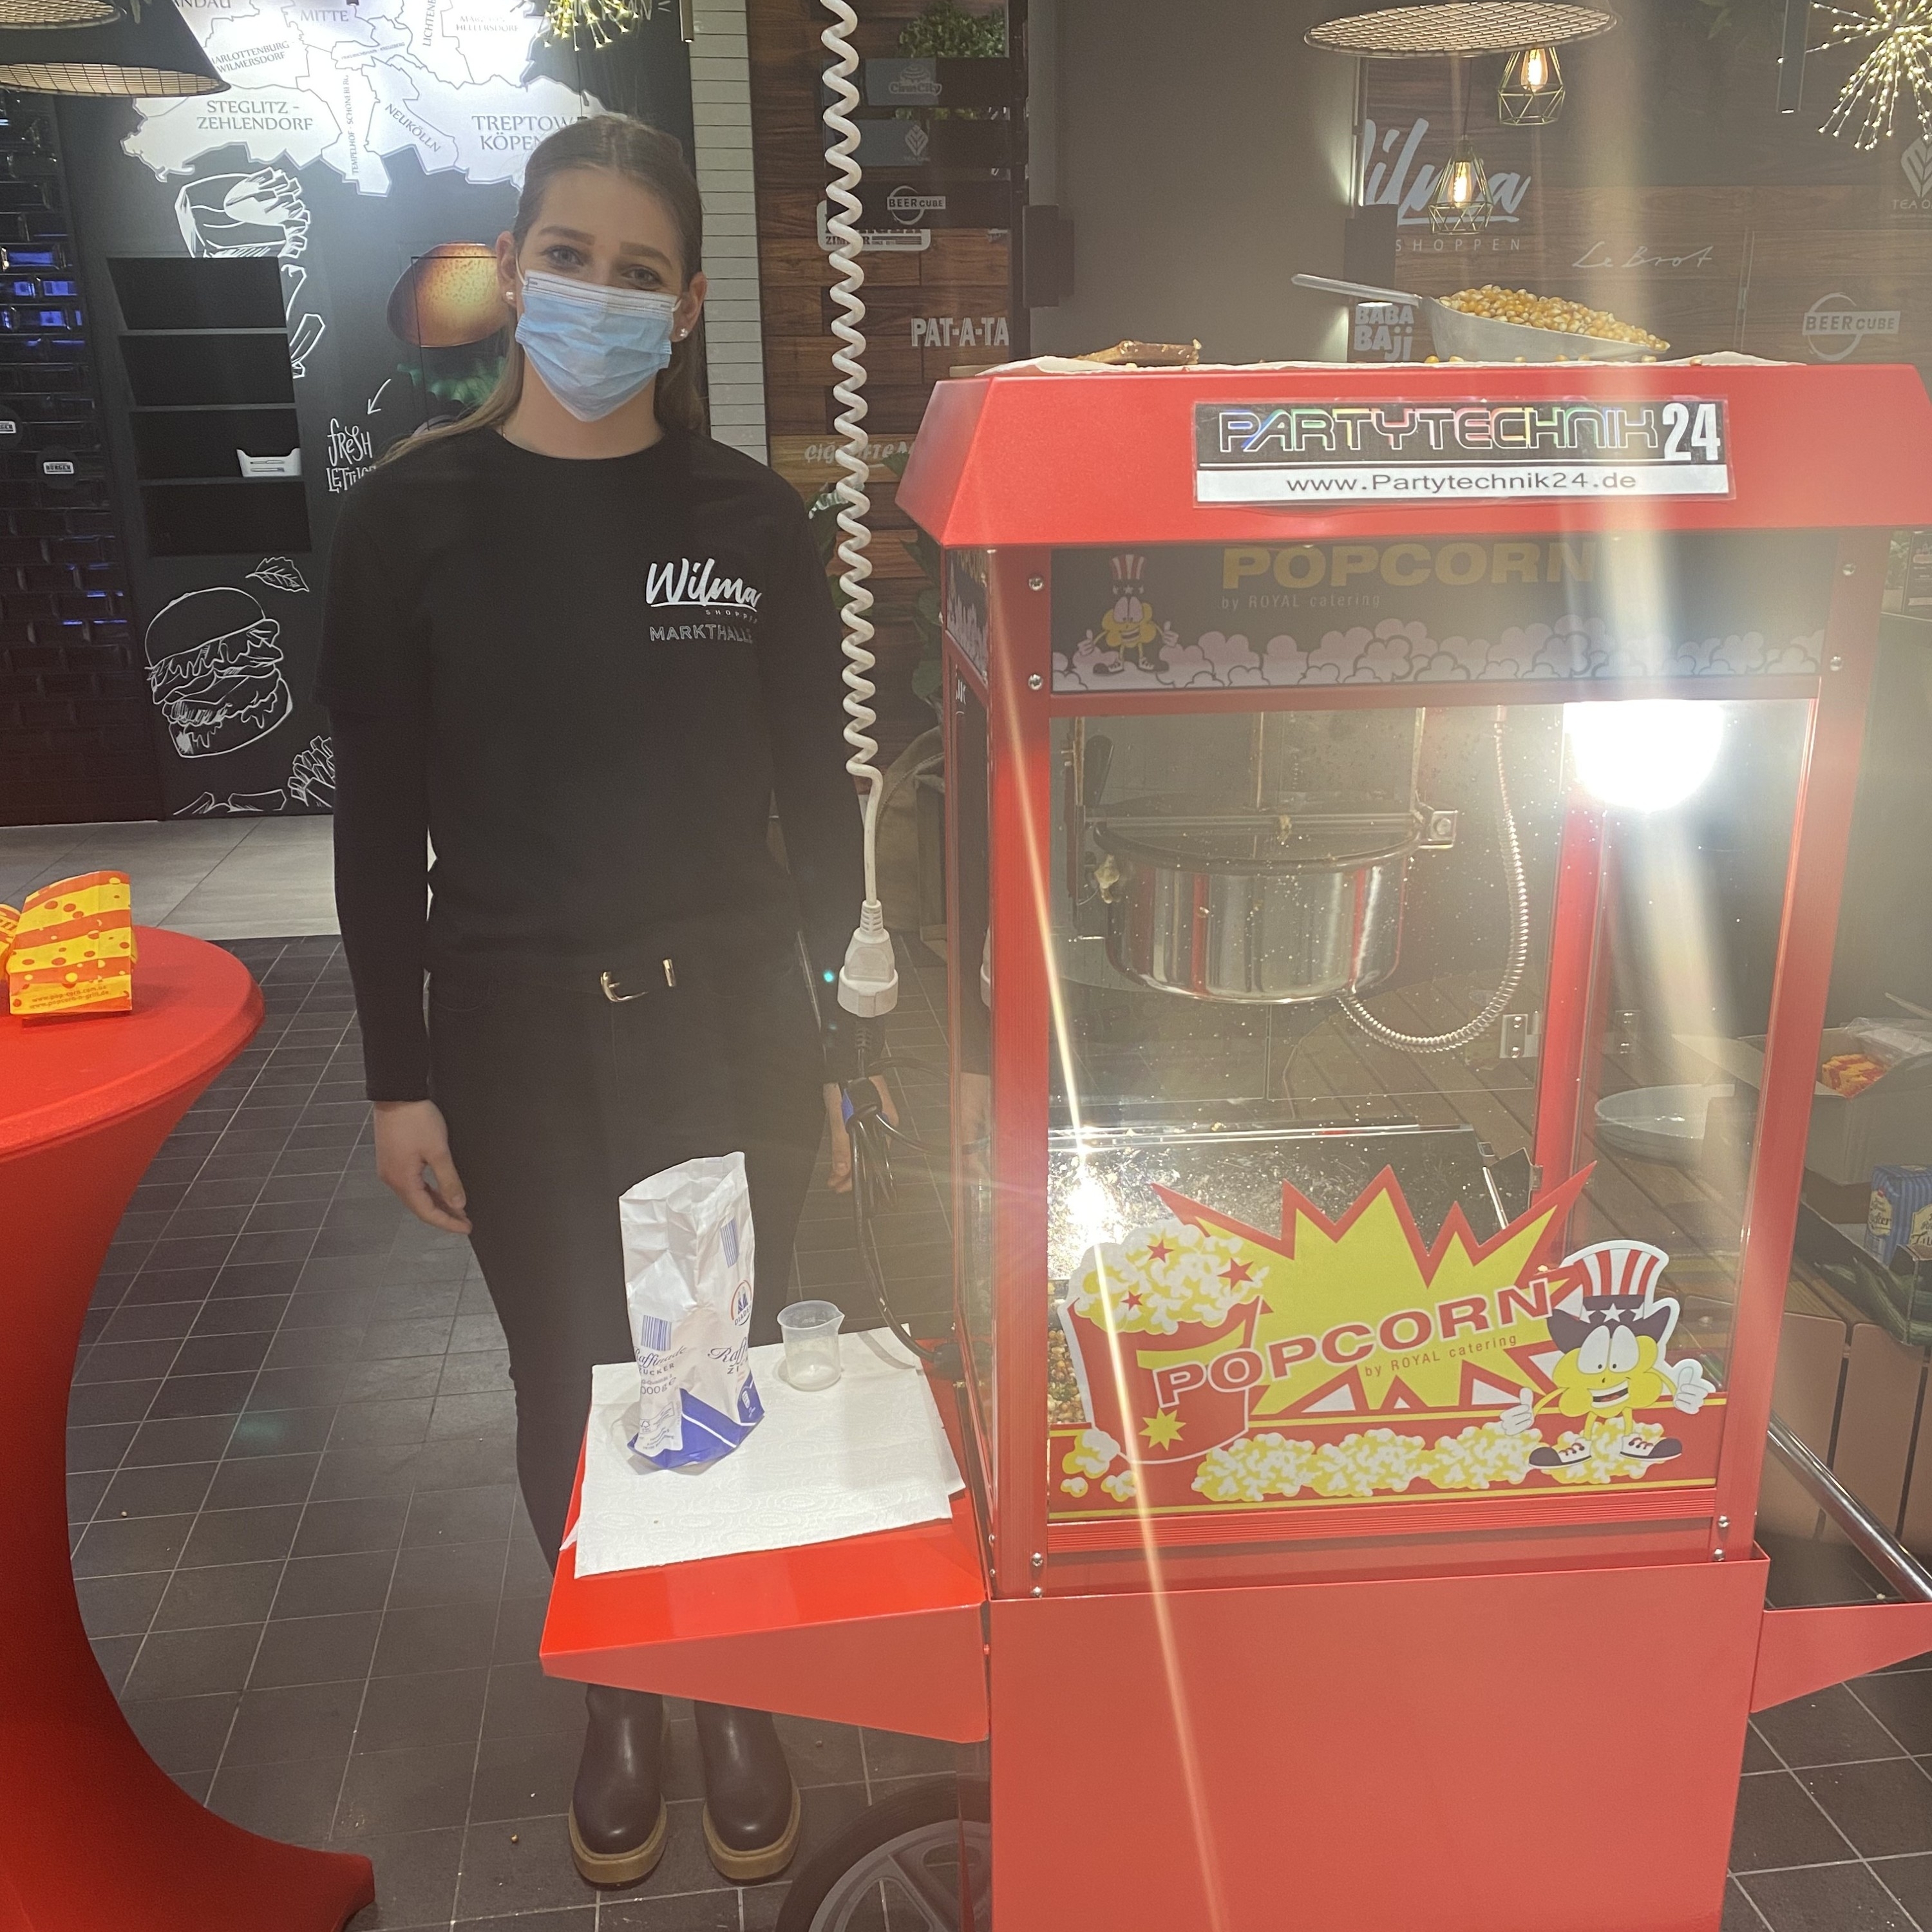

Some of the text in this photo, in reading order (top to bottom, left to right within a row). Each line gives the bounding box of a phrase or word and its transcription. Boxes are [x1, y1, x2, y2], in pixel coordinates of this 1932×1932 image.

[300, 10, 348, 21] MITTE
[211, 41, 290, 64] ARLOTTENBURG
[216, 52, 286, 73] WILMERSDORF
[207, 100, 287, 113] STEGLITZ
[196, 117, 313, 130] ZEHLENDORF
[385, 103, 441, 152] NEUKÖLLN
[348, 130, 359, 175] TEMPELHOF
[889, 198, 943, 207] BEER CUBE
[1893, 199, 1917, 210] TEA
[1395, 238, 1520, 252] SHOPPEN
[1572, 241, 1714, 268] Le Brot
[1355, 305, 1415, 325] BABA
[1805, 316, 1895, 330] BEER CUBE
[911, 317, 1009, 346] PAT-A-TA
[1218, 403, 1721, 461] PARTYTECHNIK 24
[1287, 471, 1636, 494] www.Partytechnik24.de
[1222, 541, 1597, 589] POPCORN
[645, 558, 762, 611] Wilma
[1221, 594, 1380, 611] by ROYAL catering
[1151, 1278, 1553, 1409] POPCORN
[1364, 1335, 1517, 1377] by ROYAL catering
